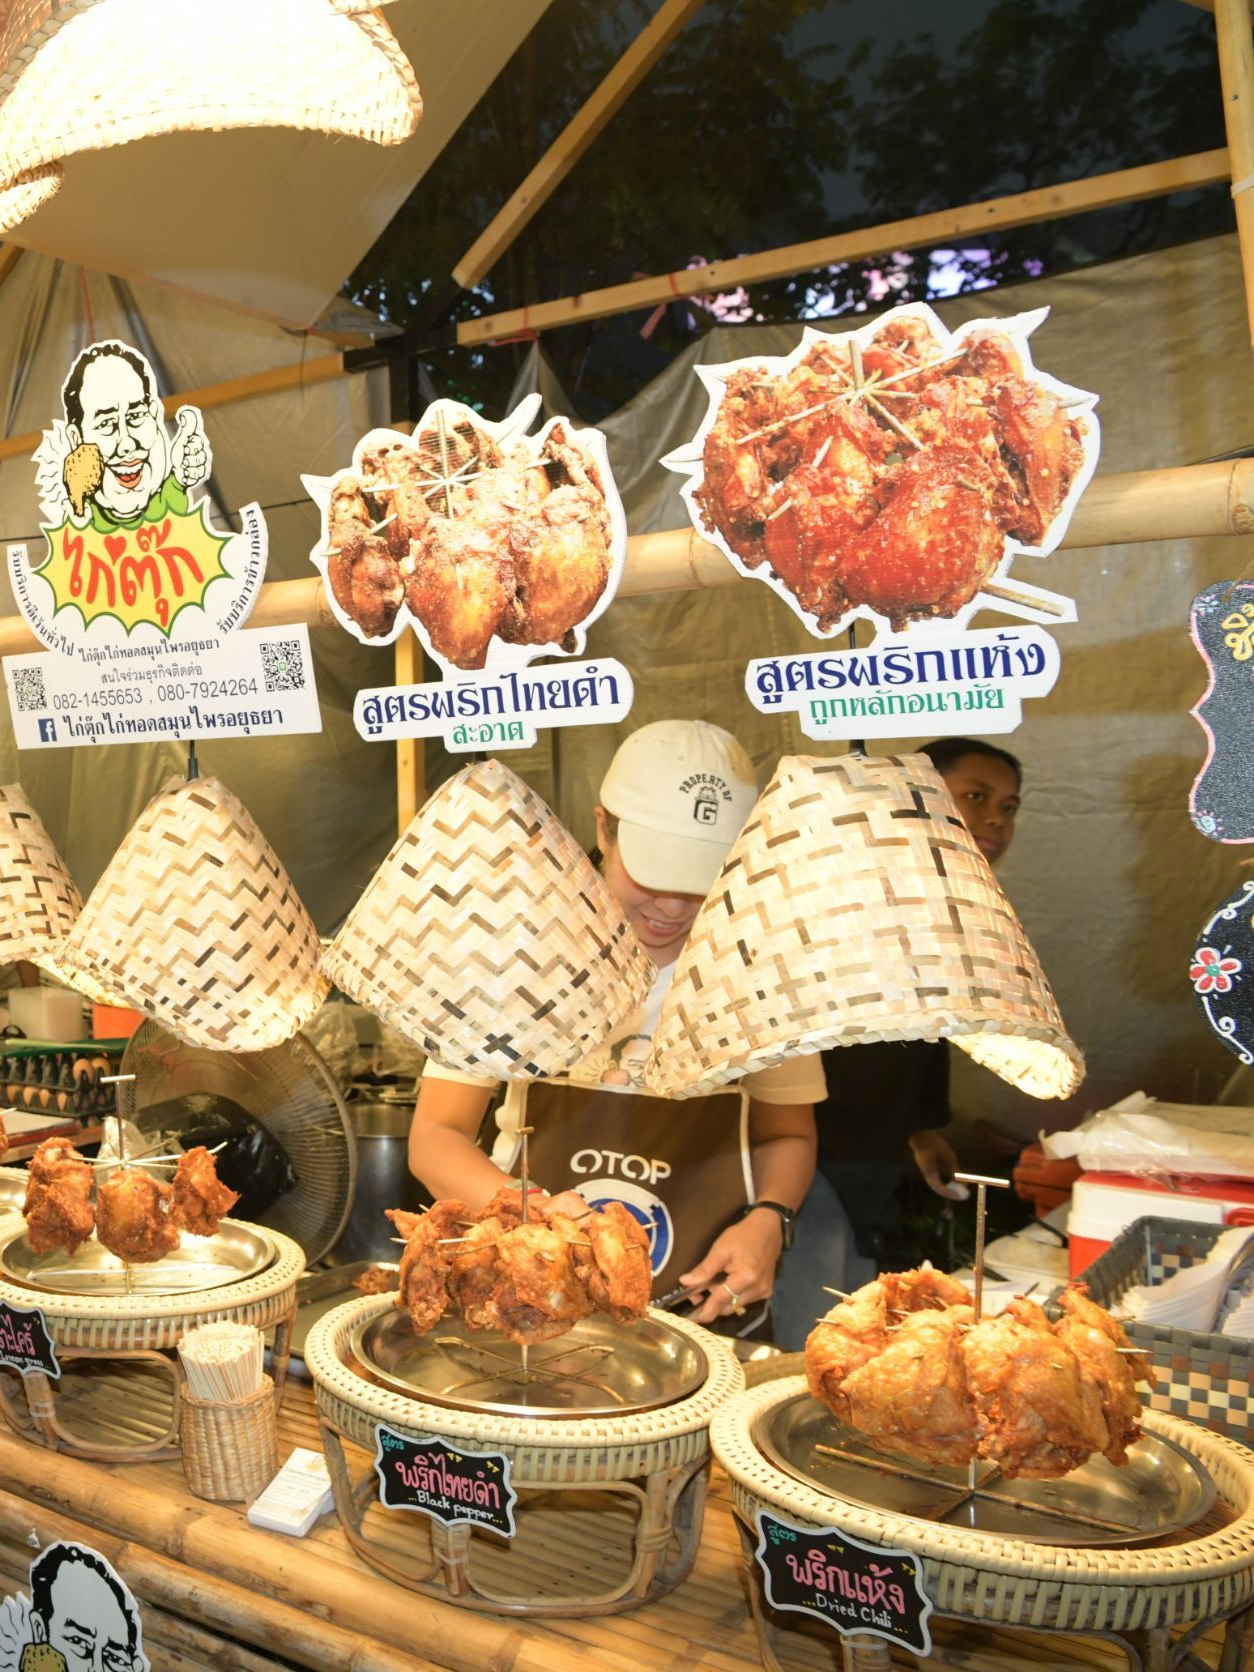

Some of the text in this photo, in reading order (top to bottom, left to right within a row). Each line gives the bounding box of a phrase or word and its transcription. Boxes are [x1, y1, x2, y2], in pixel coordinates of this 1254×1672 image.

[78, 638, 220, 666] ไก่ตุ๊กไก่ทอดสมุนไพรอยุธยา
[756, 633, 1046, 704] สูตรพริกแห้ง
[101, 661, 203, 684] สนใจร่วมธุรกิจติดต่อ
[53, 687, 143, 710] 082-1455653
[157, 678, 258, 701] 080-7924264
[362, 666, 621, 734] สูตรพริกไทยดำ
[809, 684, 1005, 725] ถูกหลักอนามัย
[63, 706, 284, 743] ไก่ตุ๊กไก่ทอดสมุนไพรอยุธยา
[452, 720, 525, 745] สะอาด
[678, 773, 733, 802] PROPERTY OF
[570, 1149, 672, 1185] OTOP
[395, 1452, 500, 1509] พริกไทยดำ
[416, 1490, 451, 1510] Black
[785, 1549, 906, 1614] พริกแห้ง
[815, 1593, 892, 1629] Dried Chili
